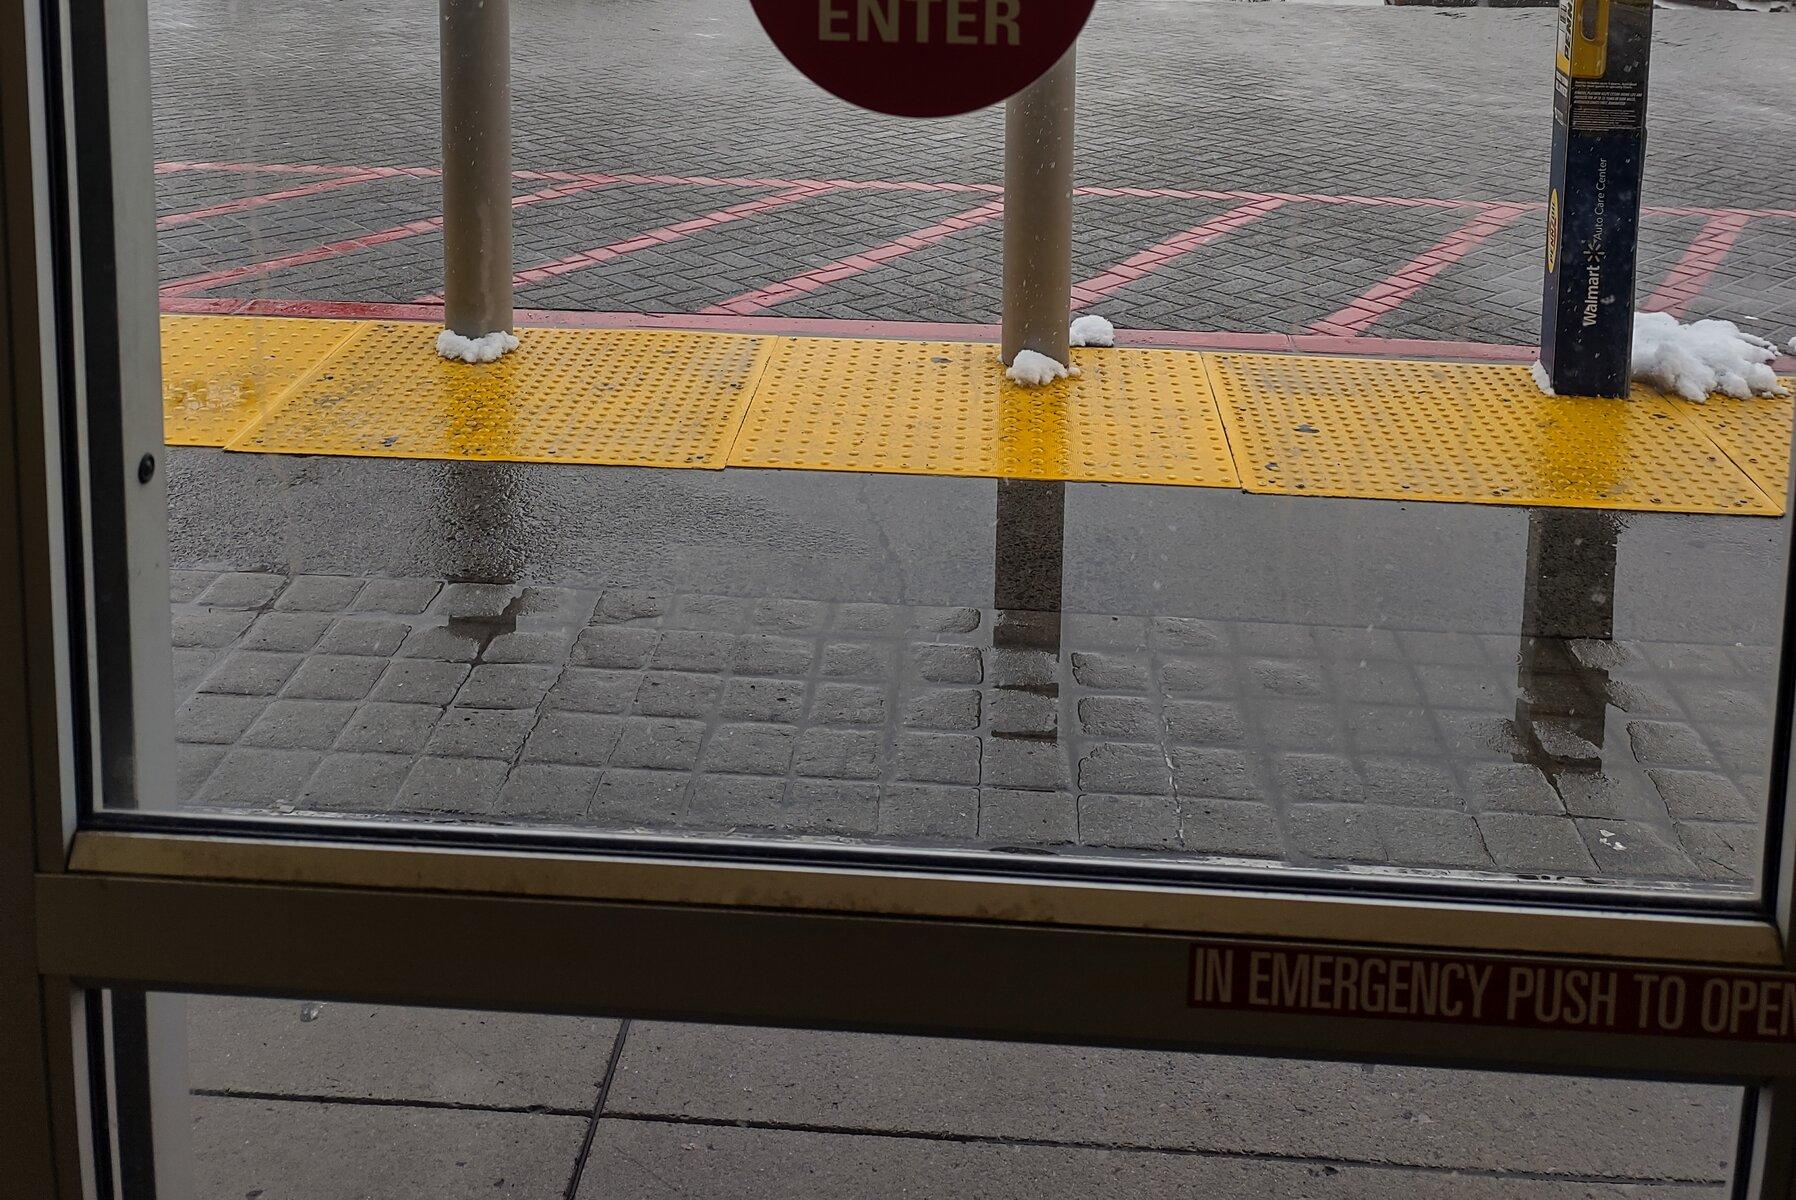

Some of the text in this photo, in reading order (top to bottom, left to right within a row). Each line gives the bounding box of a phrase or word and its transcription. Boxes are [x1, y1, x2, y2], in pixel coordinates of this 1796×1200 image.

[1593, 158, 1608, 240] Auto Care Center
[1582, 265, 1600, 327] Walmart
[1194, 947, 1233, 1003] IN
[1249, 952, 1494, 1018] EMERGENCY
[1507, 967, 1617, 1026] PUSH
[1634, 973, 1687, 1030] TO
